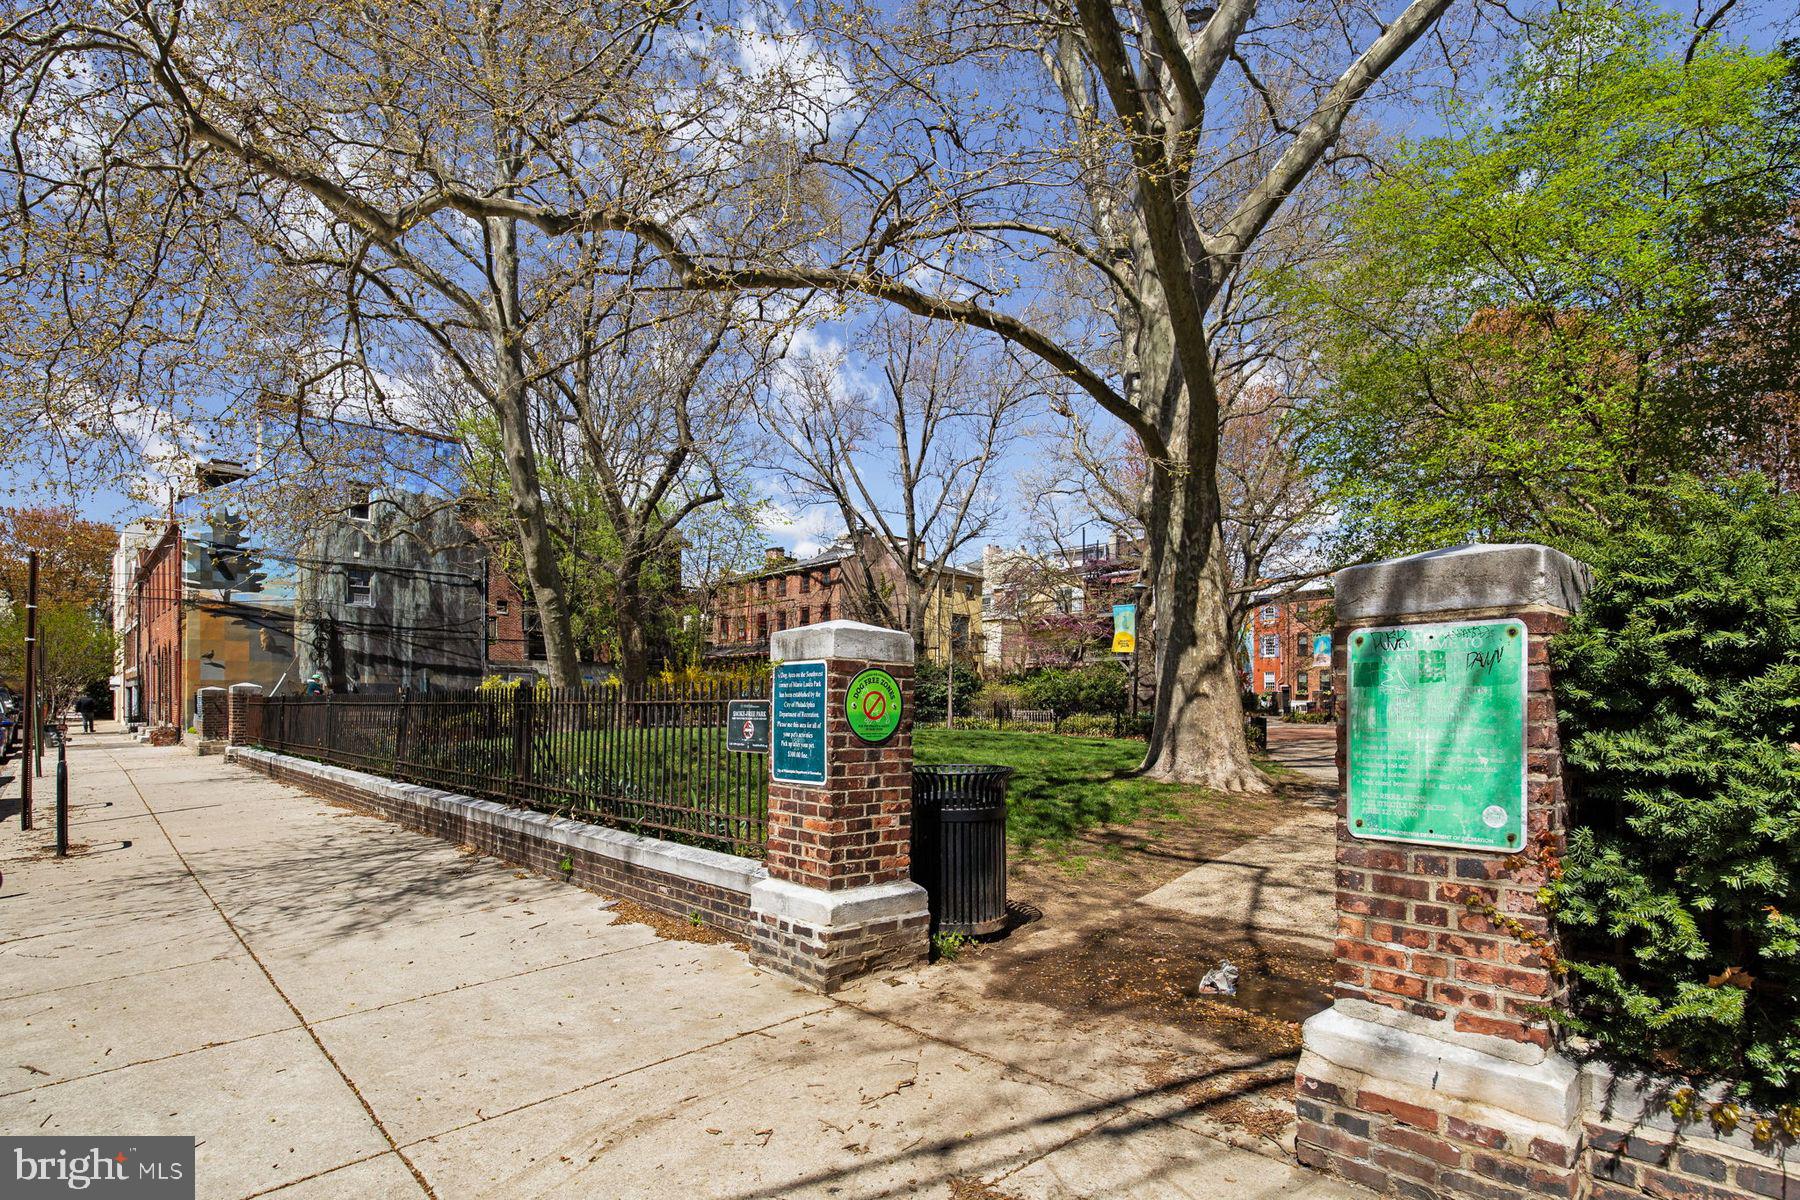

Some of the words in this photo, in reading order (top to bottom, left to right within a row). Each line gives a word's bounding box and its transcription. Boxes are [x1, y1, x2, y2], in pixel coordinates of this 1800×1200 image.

[853, 682, 865, 700] DOG
[863, 677, 880, 686] FREE
[880, 678, 896, 700] ZONES
